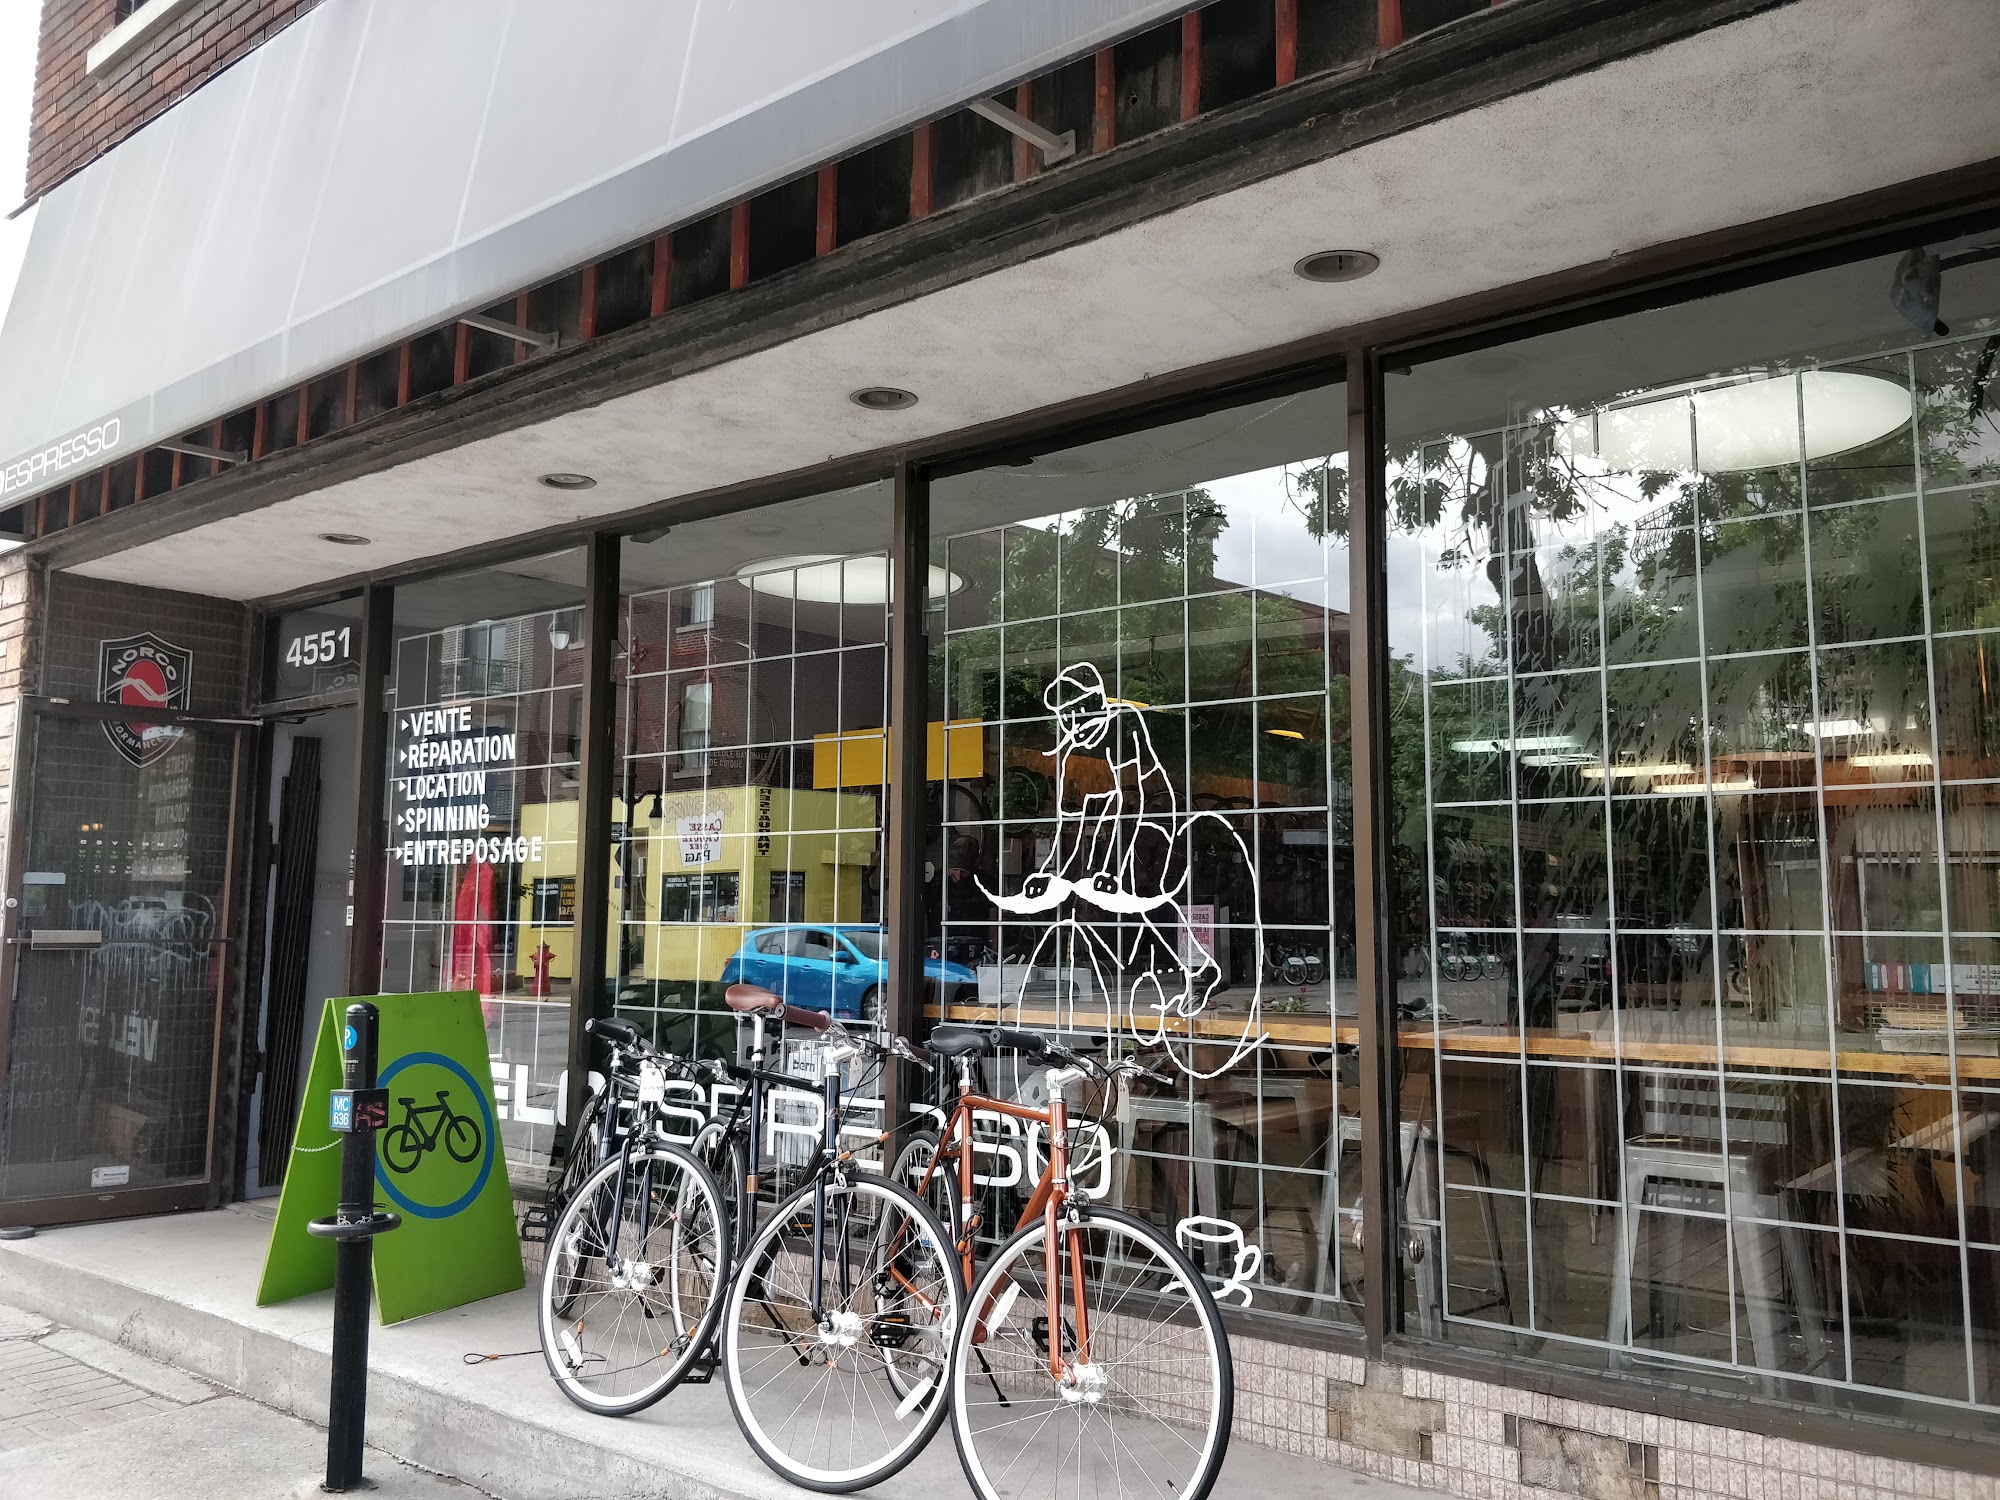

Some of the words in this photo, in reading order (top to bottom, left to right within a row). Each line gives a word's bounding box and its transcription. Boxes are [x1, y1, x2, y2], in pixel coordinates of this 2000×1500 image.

[0, 418, 120, 498] ESPRESSO
[286, 626, 351, 668] 4551
[111, 646, 177, 681] NORCO
[410, 706, 472, 737] VENTE
[407, 733, 516, 769] RÉPARATION
[406, 770, 486, 801] LOCATION
[405, 803, 490, 833] SPINNING
[403, 836, 543, 866] ENTREPOSAGE
[793, 1059, 816, 1073] bern
[333, 1112, 349, 1126] 636
[334, 1096, 349, 1112] MC
